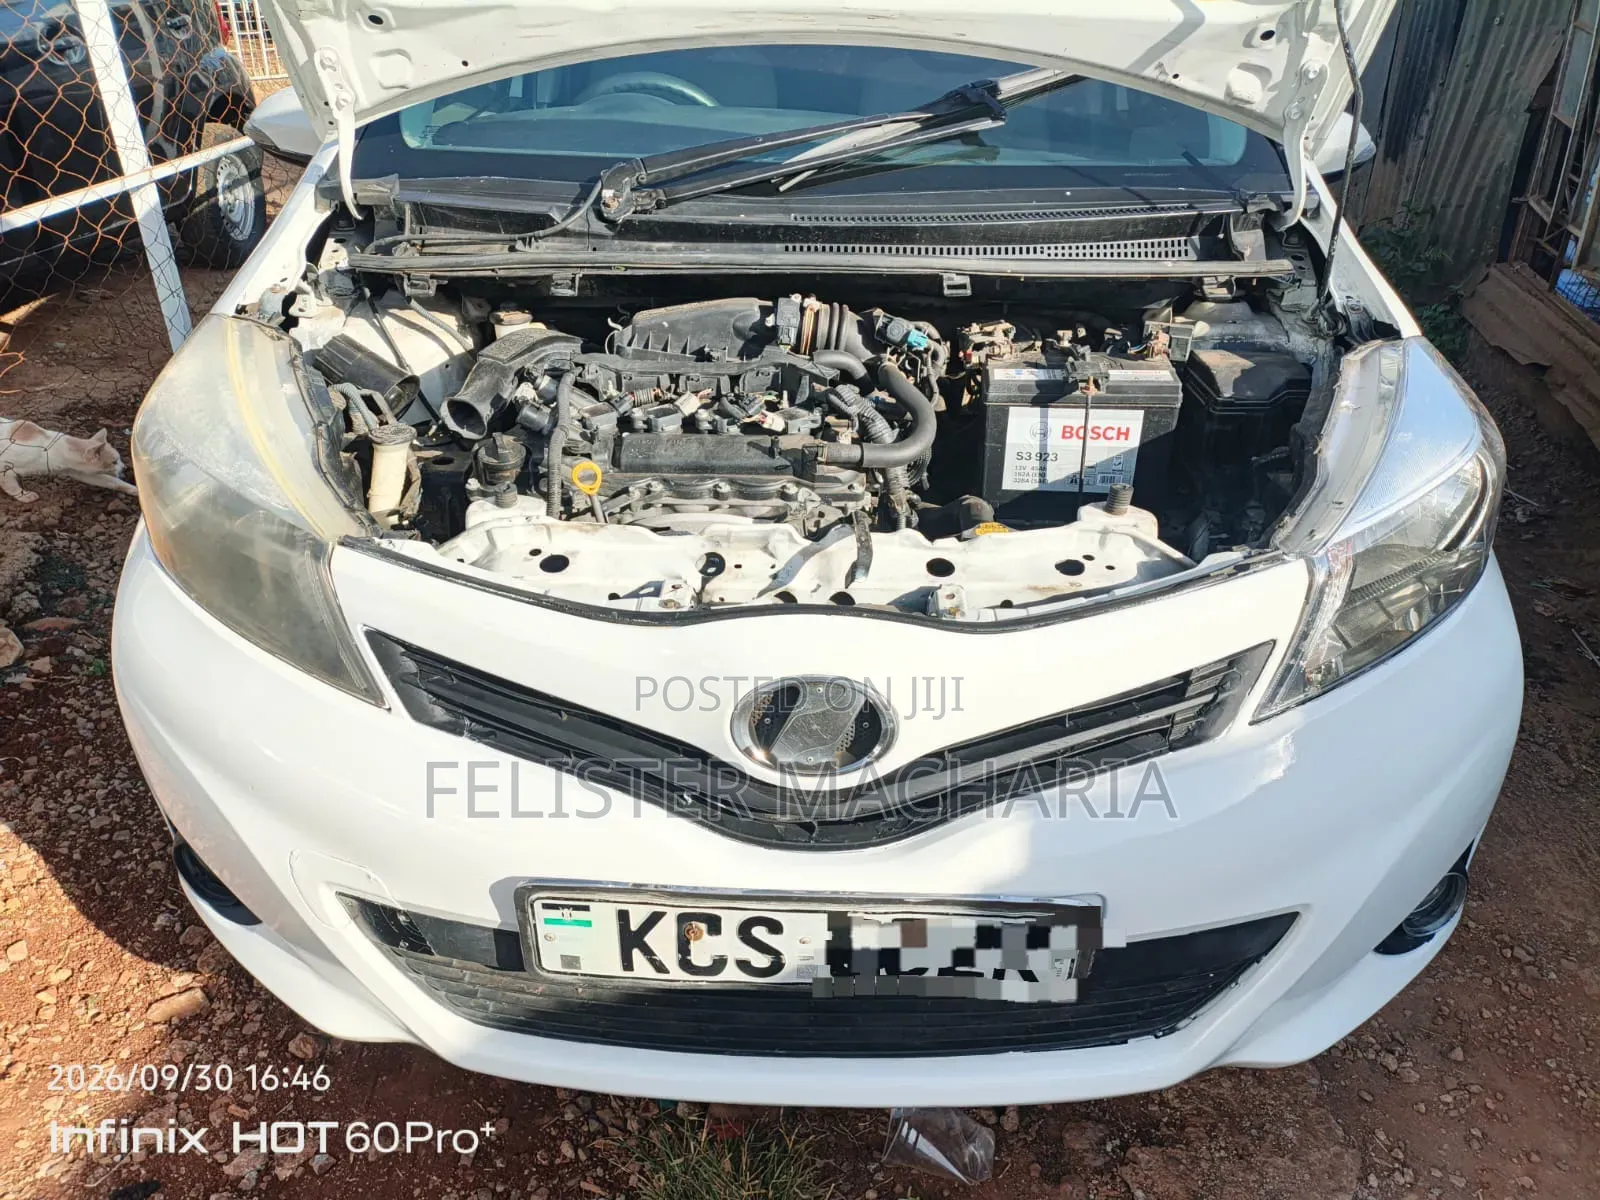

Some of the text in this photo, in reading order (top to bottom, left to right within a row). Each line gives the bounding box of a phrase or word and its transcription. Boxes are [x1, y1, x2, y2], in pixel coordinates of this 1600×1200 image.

[1061, 425, 1130, 441] BOSCH
[1015, 451, 1058, 462] S3 923
[617, 908, 787, 978] KCS
